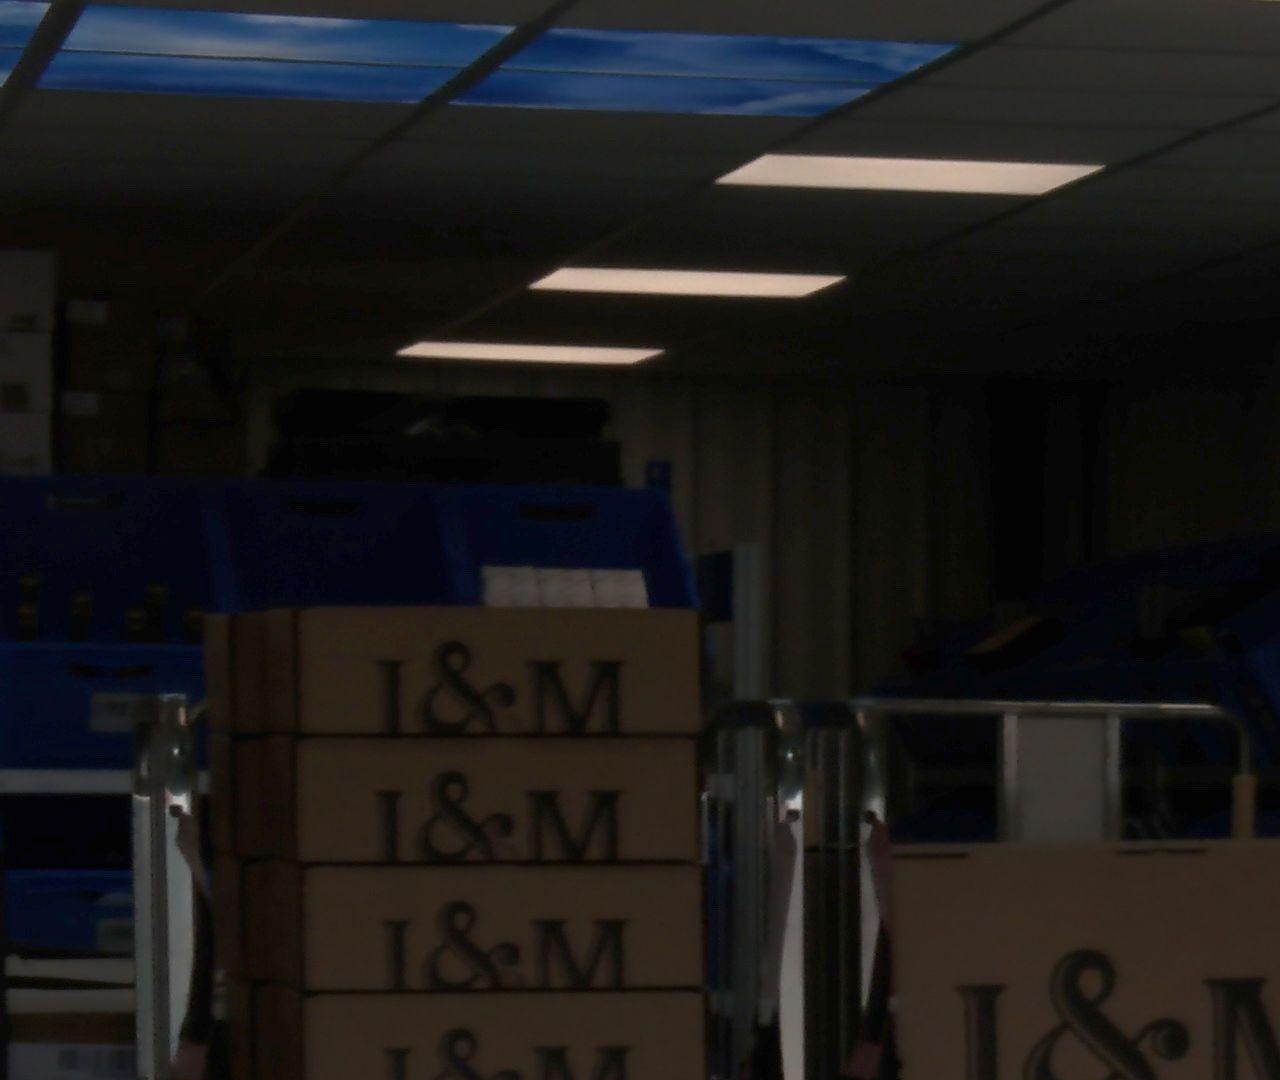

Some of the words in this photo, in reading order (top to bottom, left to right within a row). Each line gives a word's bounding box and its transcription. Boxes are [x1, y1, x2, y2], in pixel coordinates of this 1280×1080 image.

[378, 640, 624, 735] I&M
[379, 770, 624, 861] I&M
[383, 900, 627, 989] I&M
